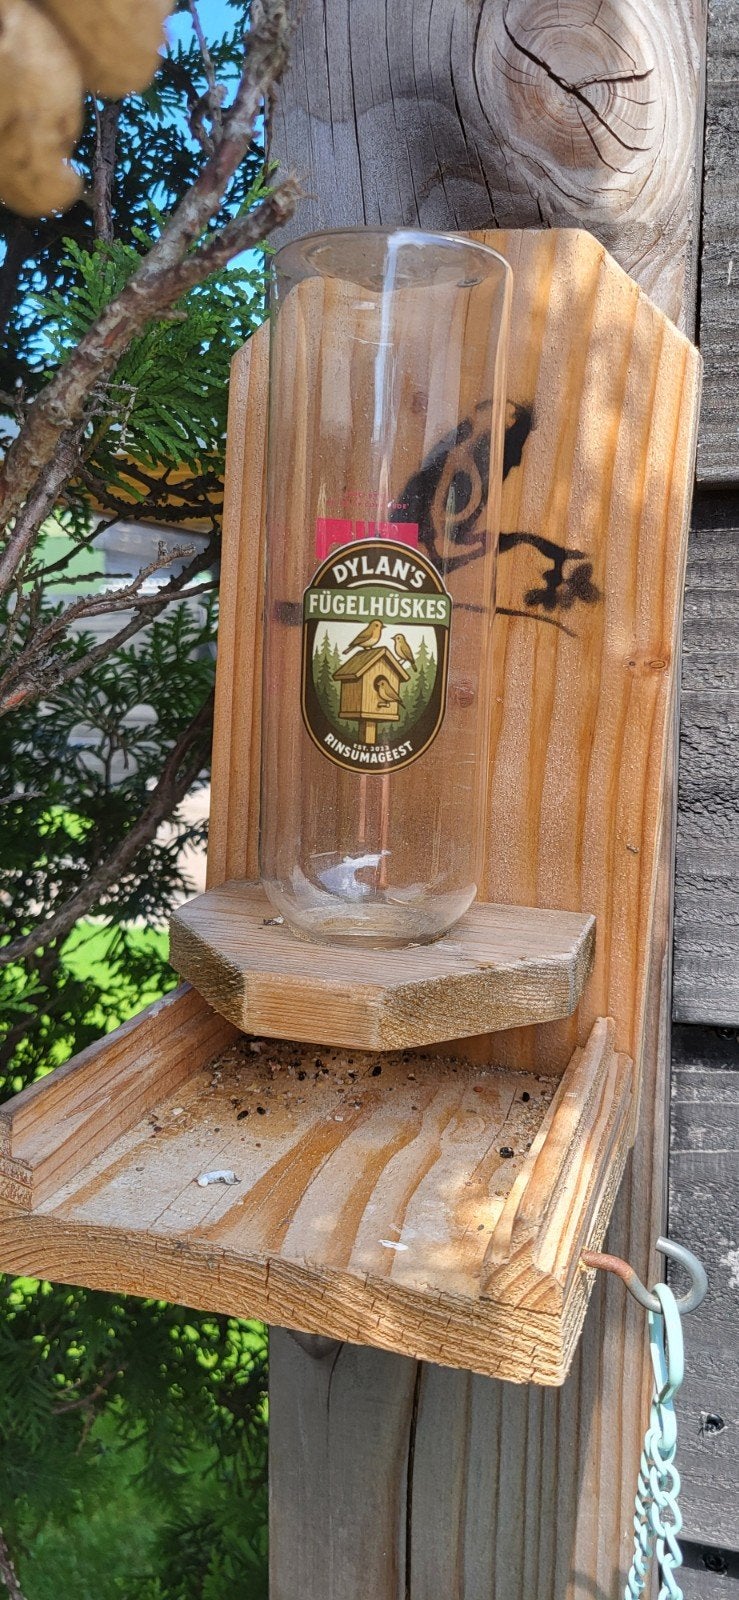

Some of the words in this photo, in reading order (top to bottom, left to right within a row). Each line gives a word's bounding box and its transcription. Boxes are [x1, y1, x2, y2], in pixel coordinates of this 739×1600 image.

[332, 556, 426, 588] DYLAN'S
[309, 591, 446, 619] FÜGELHÜSKES
[324, 732, 414, 764] RINSUMAGEEST
[353, 743, 369, 752] EST.
